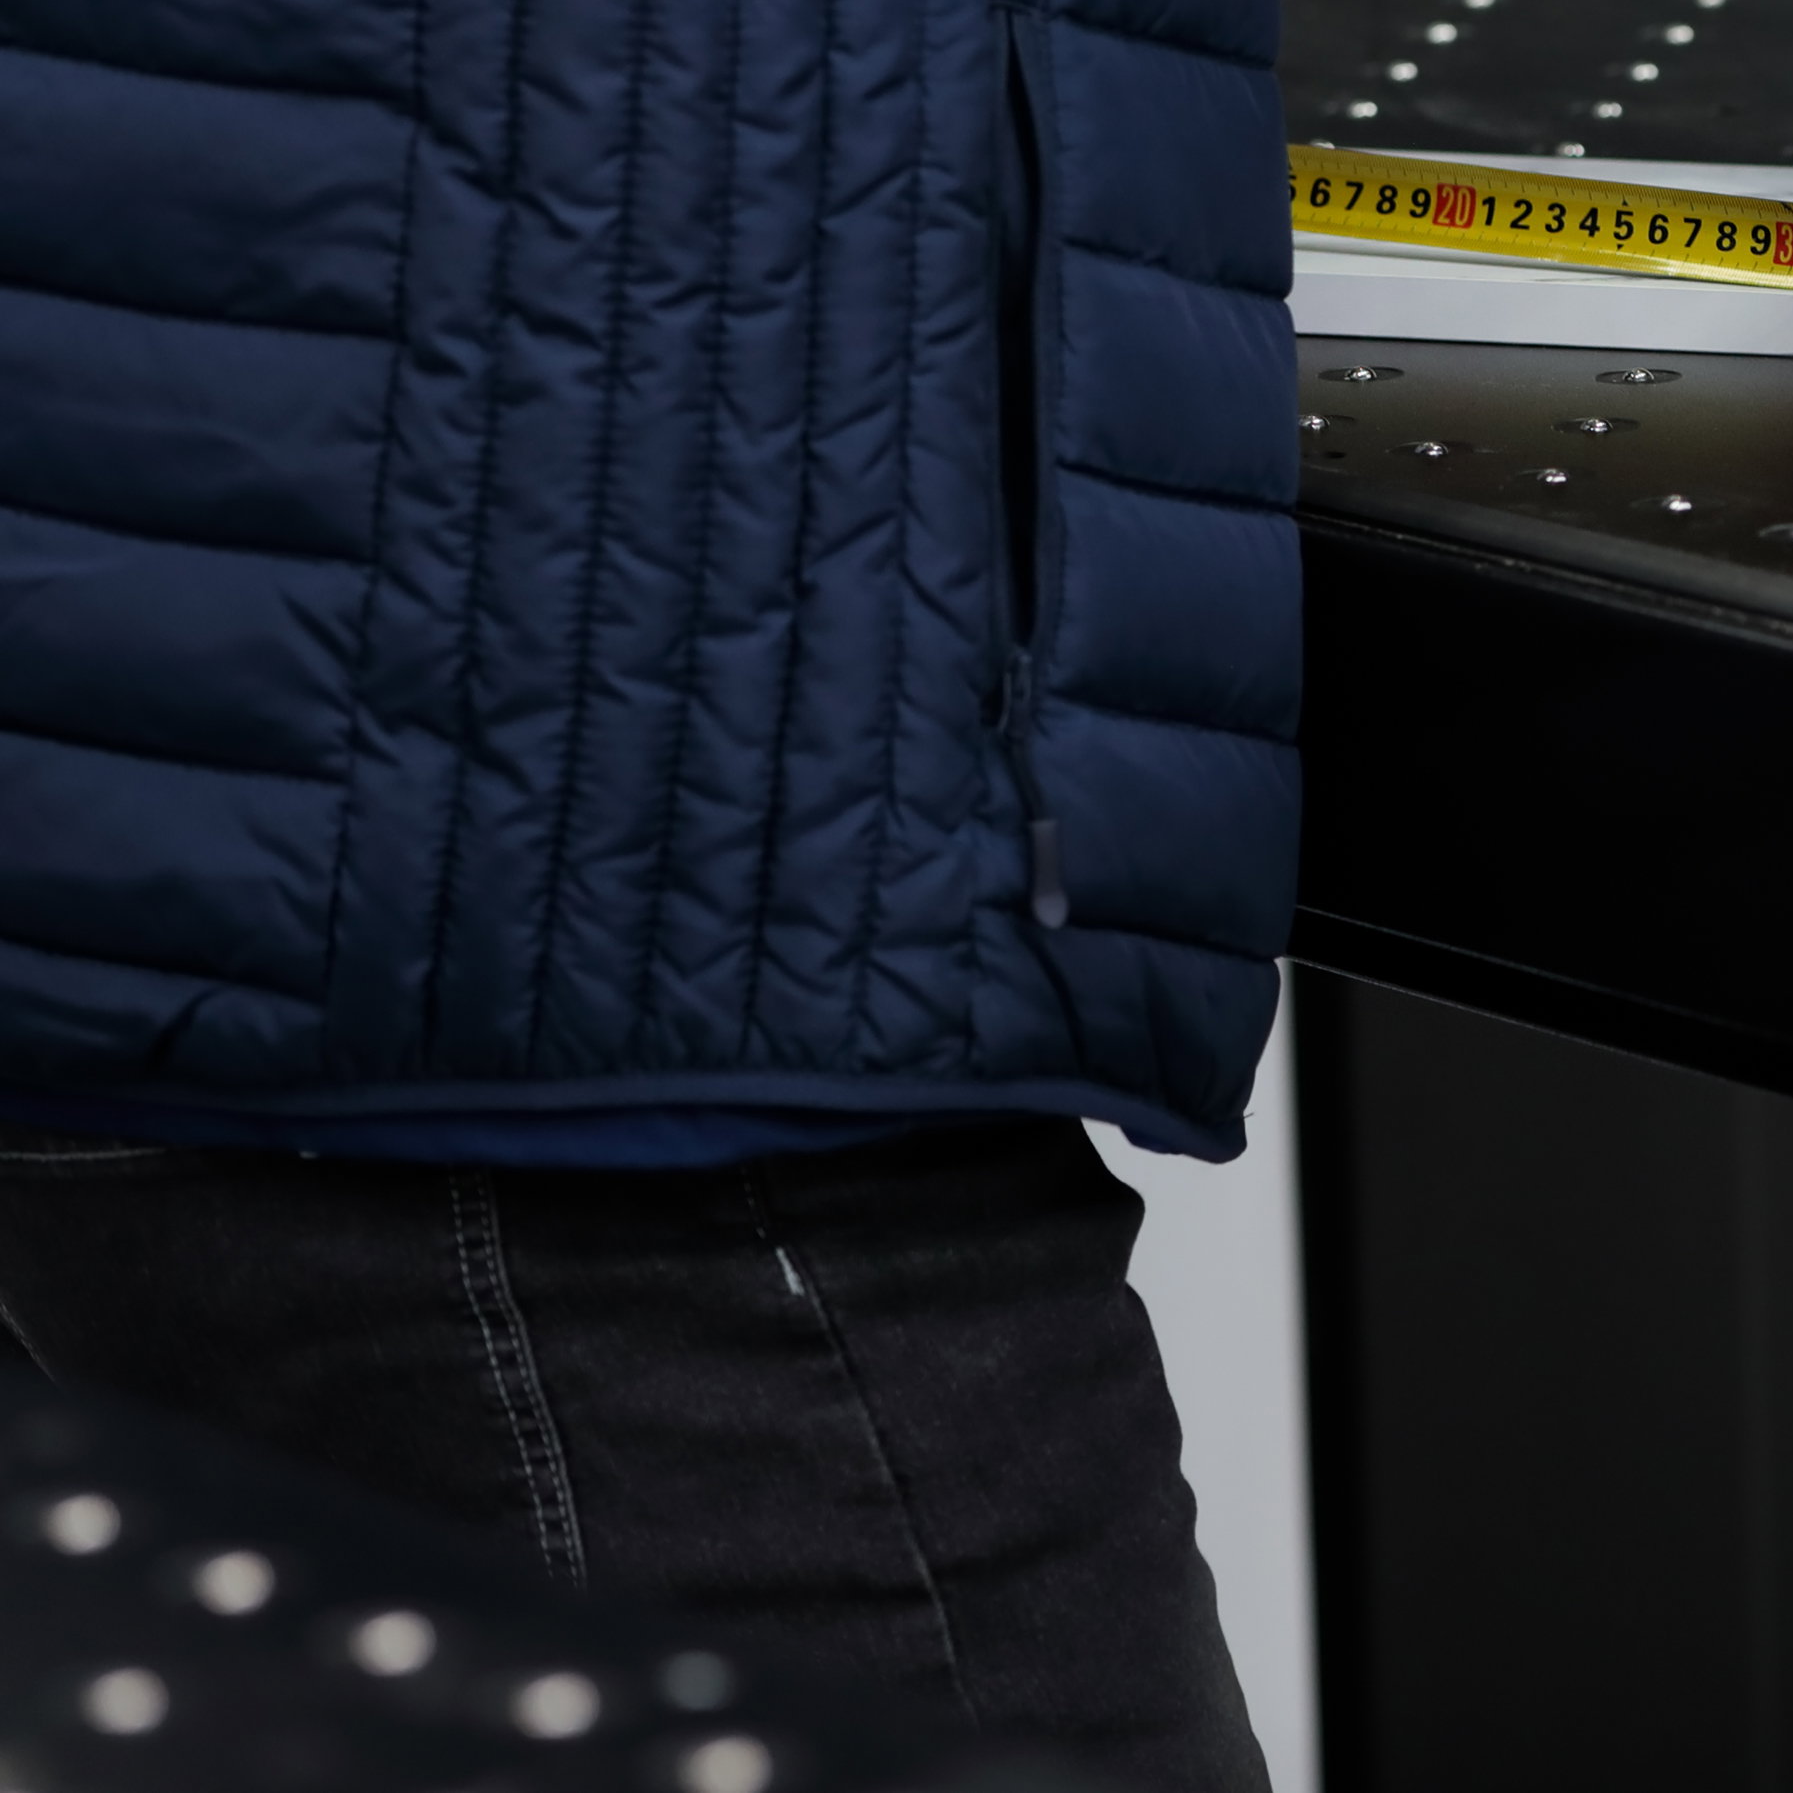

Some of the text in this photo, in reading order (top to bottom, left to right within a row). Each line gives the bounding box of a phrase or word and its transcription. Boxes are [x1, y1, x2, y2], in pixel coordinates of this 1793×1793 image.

[1310, 177, 1332, 208] 6
[1345, 181, 1365, 211] 7
[1376, 184, 1399, 215] 8
[1409, 188, 1432, 219] 9
[1437, 186, 1470, 226] 20
[1481, 196, 1497, 226] 1
[1510, 199, 1534, 230] 2
[1544, 202, 1567, 234] 3
[1578, 207, 1601, 238] 4
[1612, 210, 1635, 241] 5
[1647, 213, 1670, 245] 6
[1682, 217, 1703, 248] 7
[1715, 220, 1738, 252] 8
[1750, 224, 1772, 256] 9
